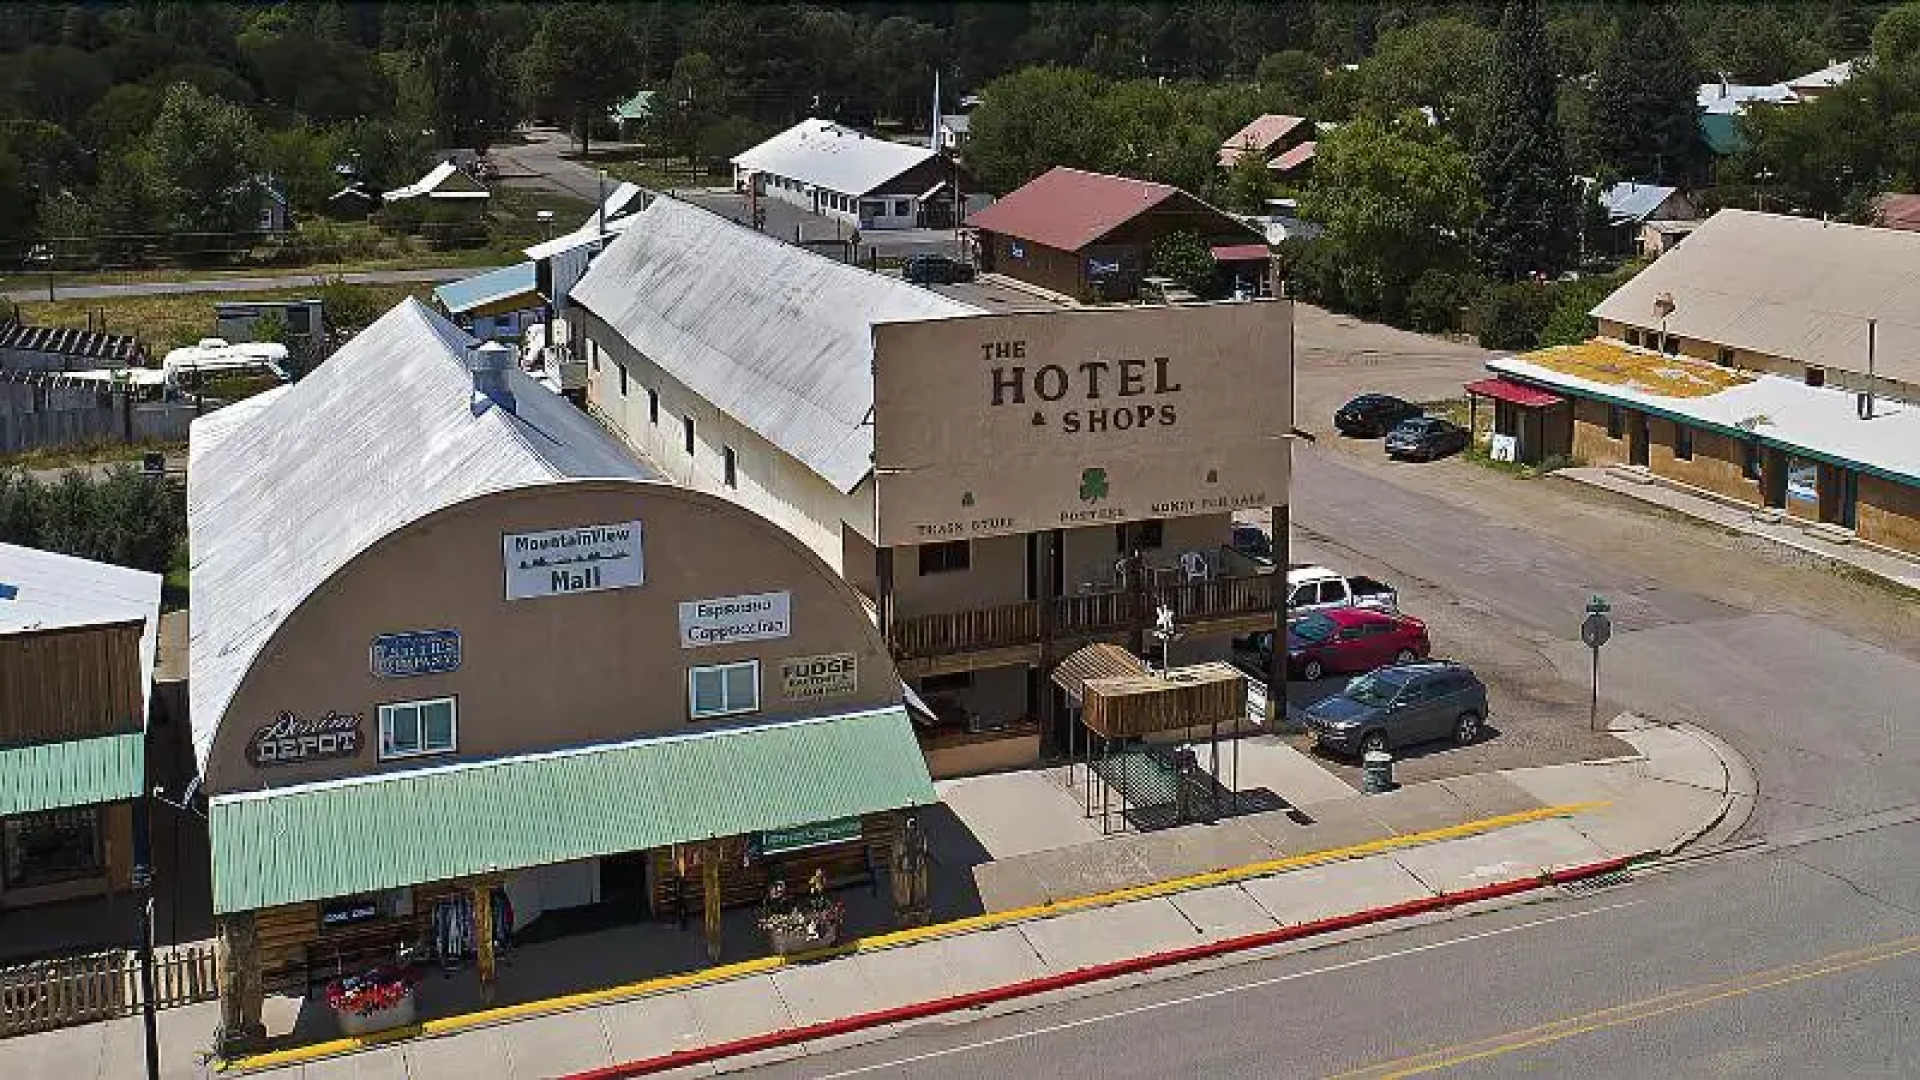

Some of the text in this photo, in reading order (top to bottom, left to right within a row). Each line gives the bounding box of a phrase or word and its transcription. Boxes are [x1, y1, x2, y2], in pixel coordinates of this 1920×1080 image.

[981, 341, 1026, 360] THE
[990, 357, 1182, 407] HOTEL
[1063, 405, 1177, 432] SHOPS
[551, 565, 601, 592] Mall
[784, 656, 856, 679] FUDGE
[256, 731, 357, 762] DEPOT
